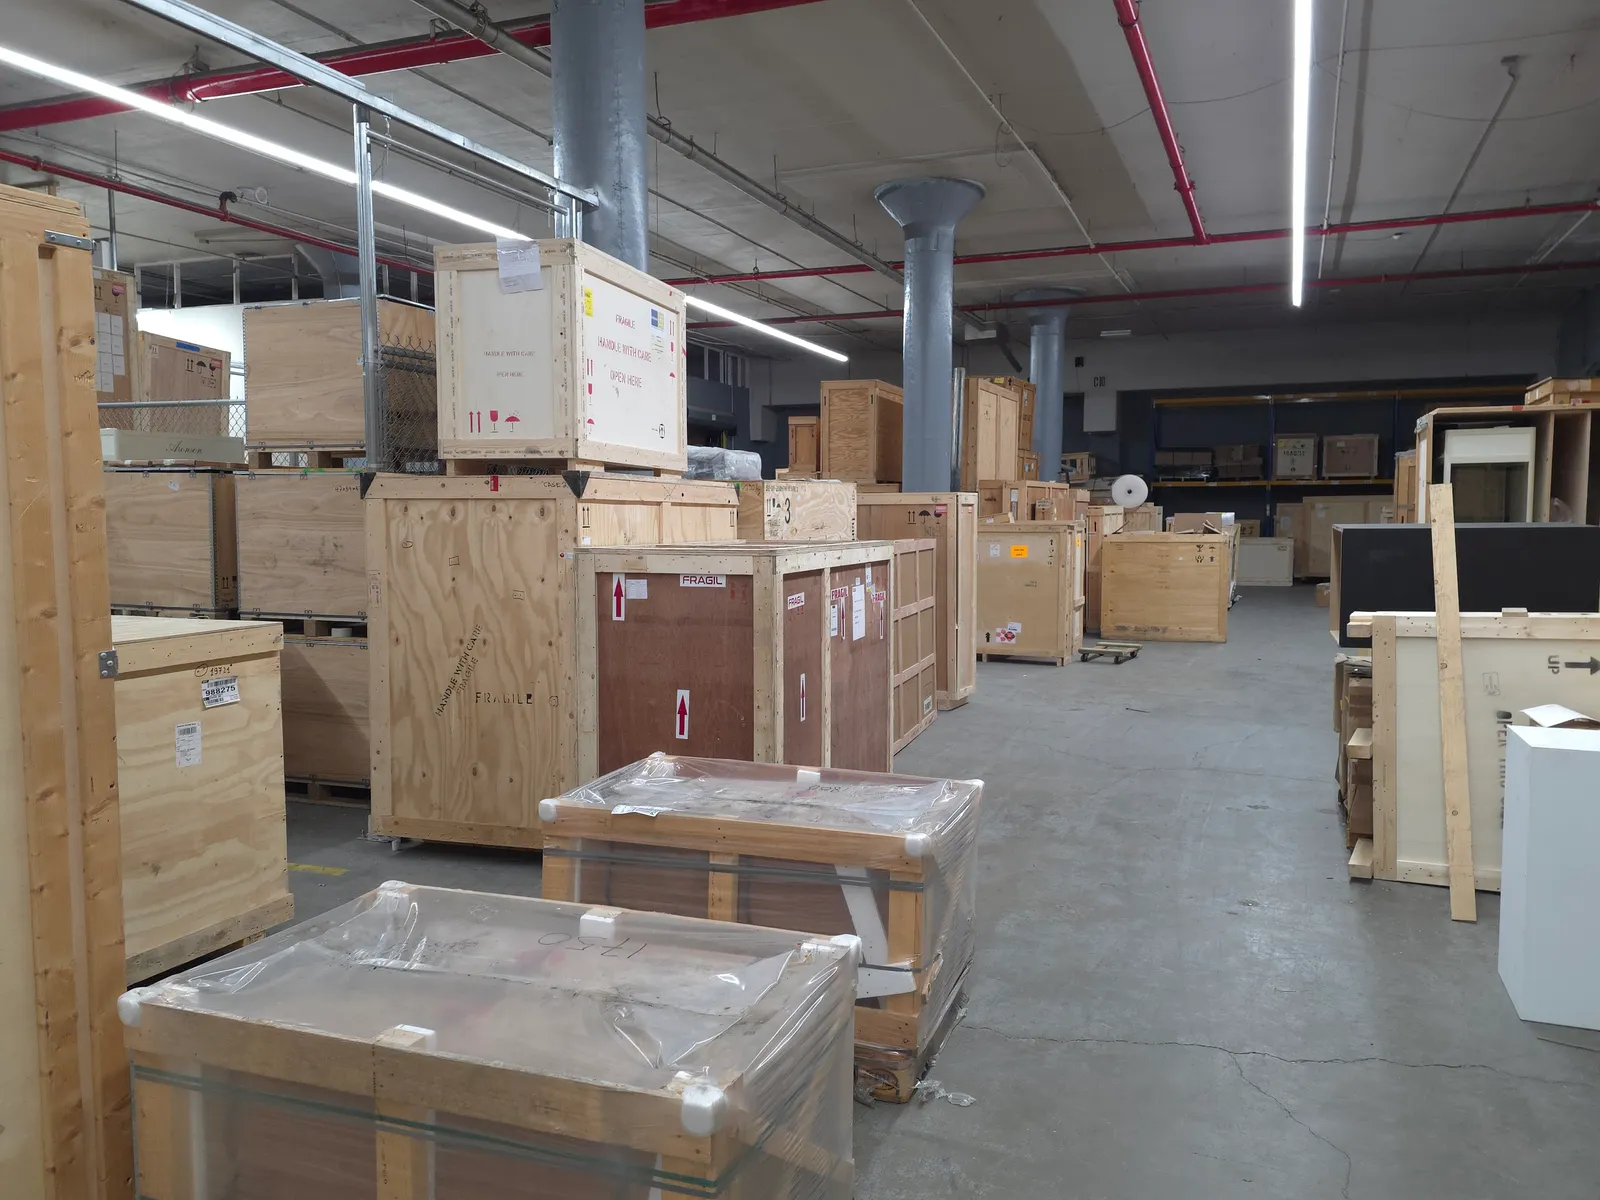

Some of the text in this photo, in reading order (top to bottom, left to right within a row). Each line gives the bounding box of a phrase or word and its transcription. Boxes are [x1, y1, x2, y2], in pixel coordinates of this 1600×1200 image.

[616, 314, 635, 329] FRAGILE
[598, 336, 621, 353] HANDLE
[622, 343, 637, 358] WITH
[637, 349, 652, 362] CARE
[610, 369, 642, 388] OPEN HERE
[784, 497, 791, 524] 3
[682, 576, 723, 585] FRAGIL
[788, 595, 804, 608] FRAGIL
[831, 587, 848, 600] FRAGIL
[435, 624, 483, 717] HANDLE WITH CARE
[1548, 655, 1560, 675] UP
[456, 656, 479, 696] FRAGILE
[205, 684, 236, 697] 988275
[475, 691, 533, 705] FRAGILE
